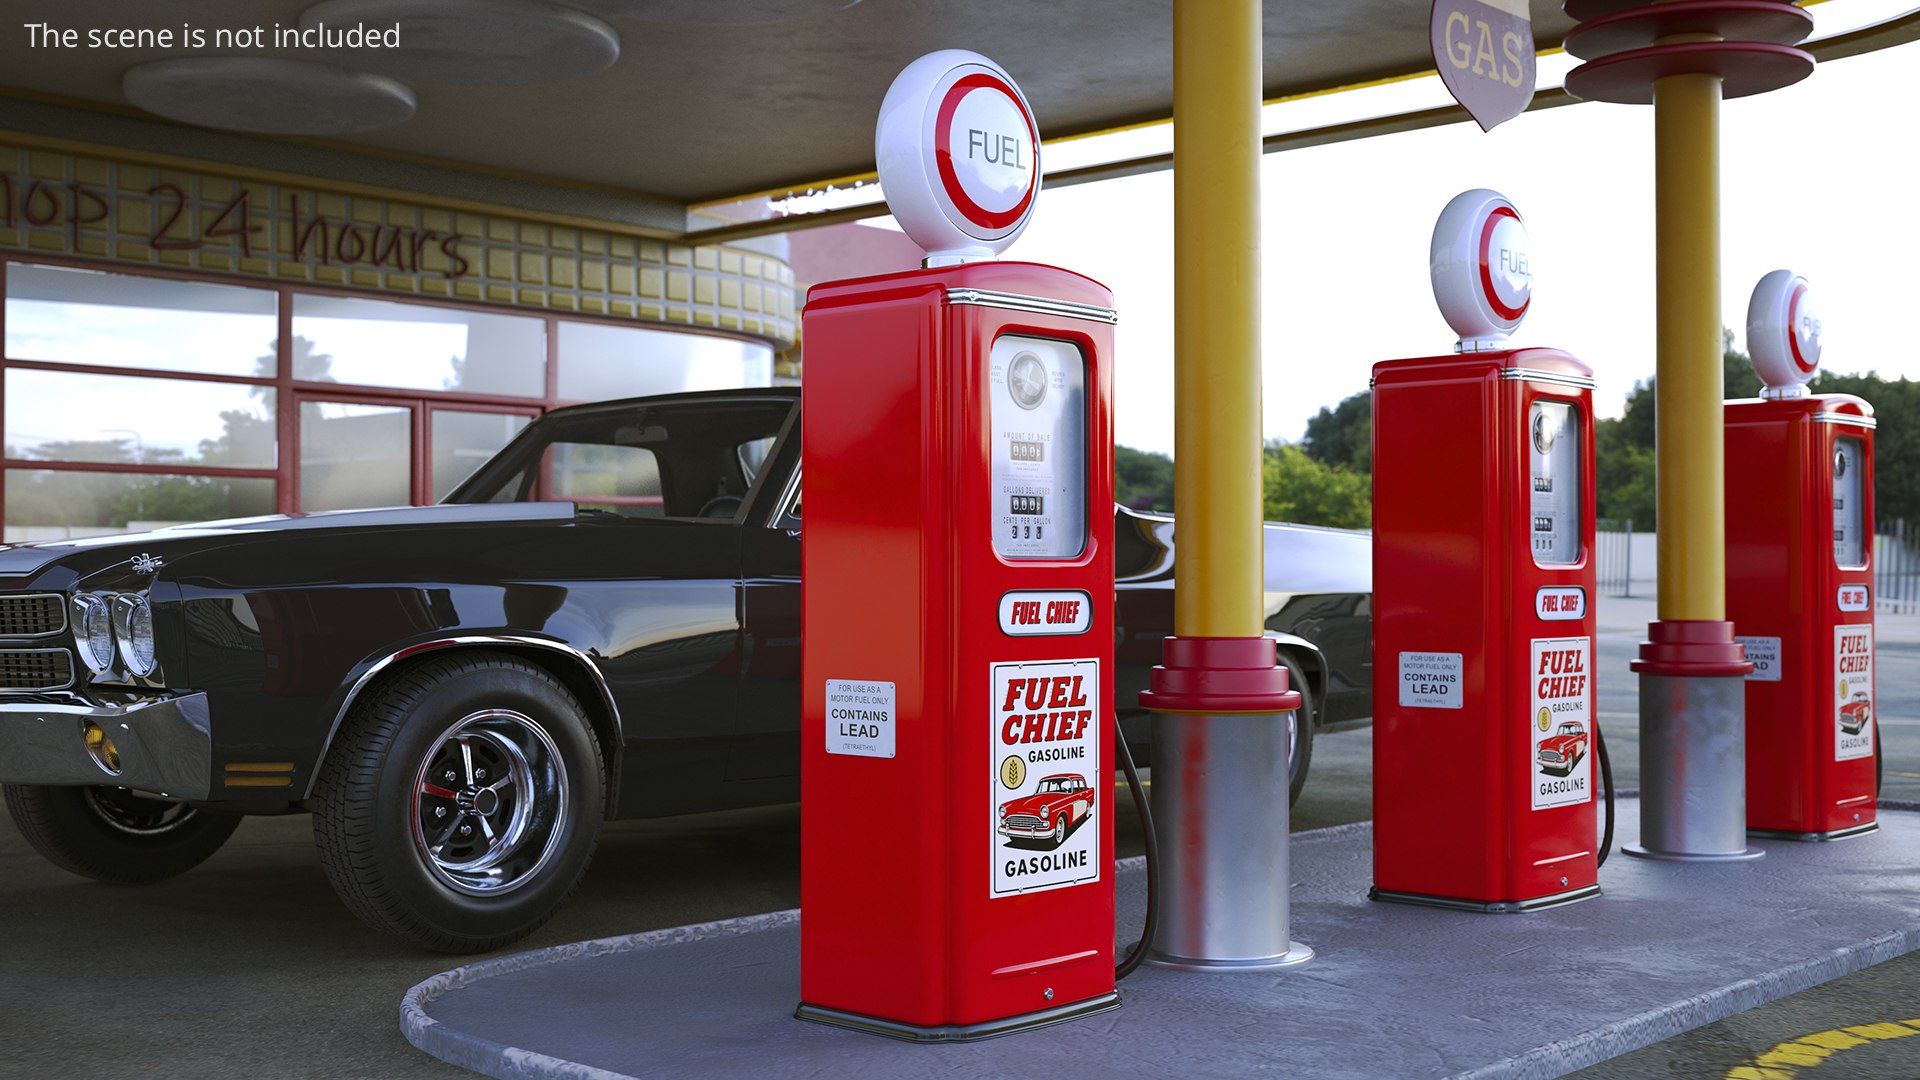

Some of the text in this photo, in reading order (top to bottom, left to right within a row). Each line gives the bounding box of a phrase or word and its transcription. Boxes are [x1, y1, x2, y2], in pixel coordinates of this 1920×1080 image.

[1445, 11, 1523, 88] GAS
[968, 128, 1027, 171] FUEL
[148, 184, 263, 258] 24
[290, 194, 469, 279] hours
[1500, 248, 1532, 276] FUEL
[1003, 431, 1025, 440] AMOUNT
[1003, 485, 1051, 495] GALLONS DELIVERED
[1003, 516, 1052, 526] CENTS PER GALLON
[1542, 594, 1579, 612] FUEL CHIEF
[1010, 600, 1081, 625] FUEL CHIEF
[1840, 635, 1868, 654] FUEL
[1538, 649, 1584, 675] FUEL
[1744, 653, 1776, 661] NTAINS
[1839, 655, 1870, 674] CHIEF
[1753, 662, 1769, 670] AD
[1404, 673, 1456, 683] CONTAINS
[853, 685, 866, 693] USE
[867, 686, 876, 694] AS
[1002, 675, 1087, 712] FUEL
[1412, 683, 1448, 695] LEAD
[1538, 675, 1586, 700] CHIEF
[830, 695, 889, 705] MOTOR FUEL ONLY
[1552, 701, 1583, 713] GASOLINE
[831, 708, 888, 722] CONTAINS
[840, 723, 879, 738] LEAD
[1001, 709, 1092, 746] CHIEF
[842, 743, 876, 752] (TETRAETHYL)
[1840, 736, 1869, 750] GASOLINE
[1028, 746, 1085, 763] GASOLINE
[1540, 777, 1585, 796] GASOLINE
[1004, 849, 1088, 878] GASOLINE
